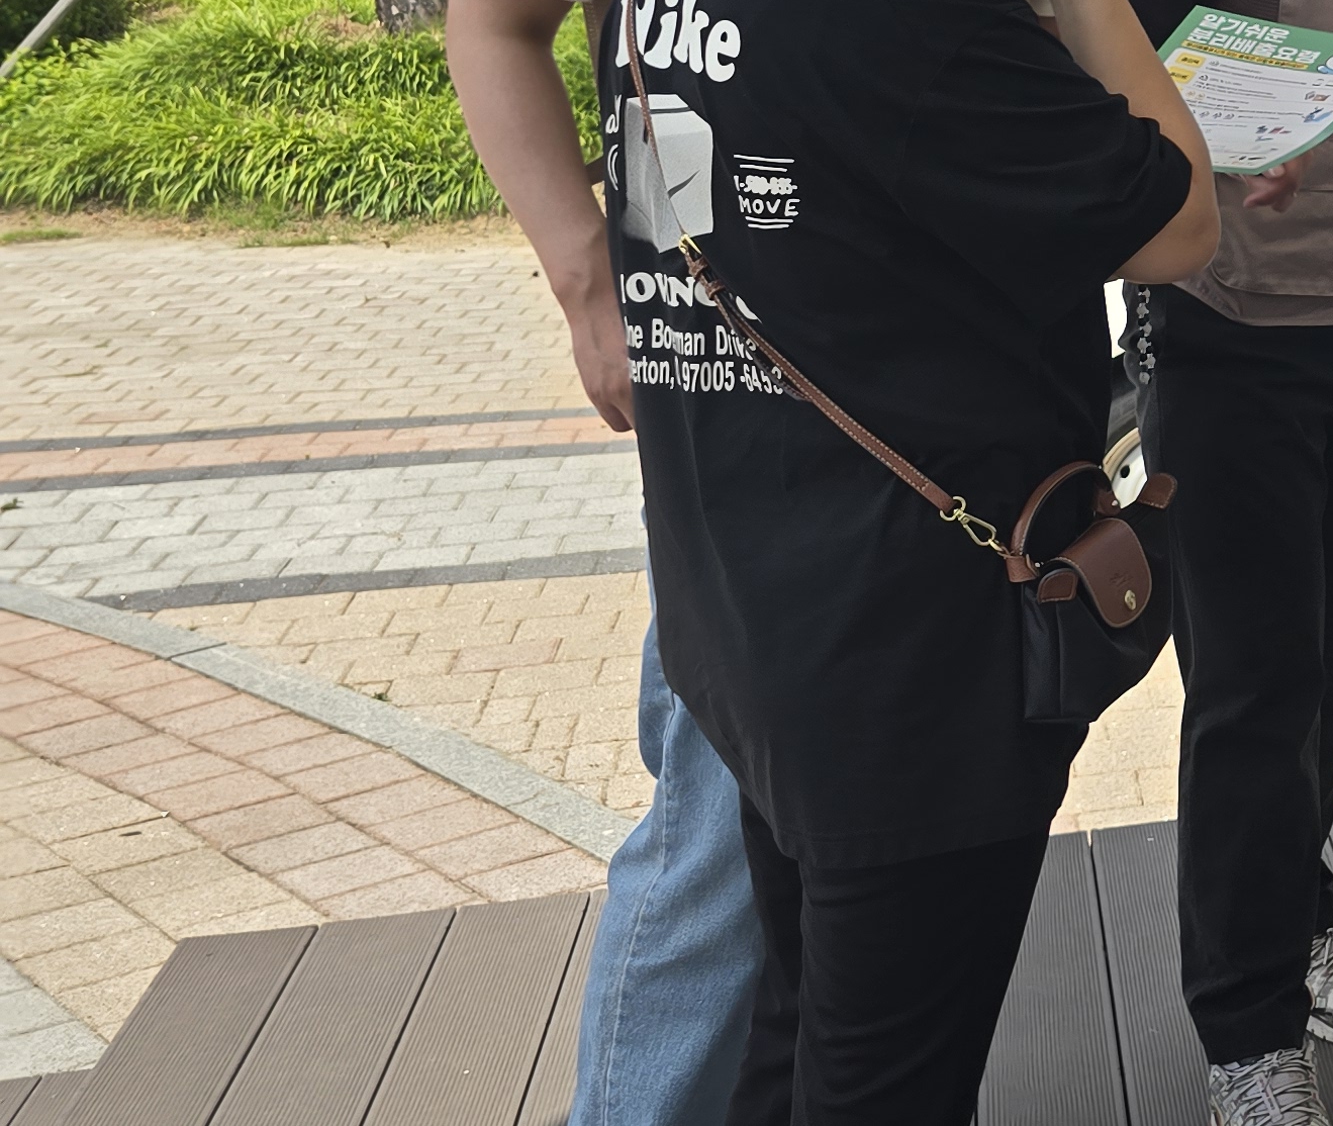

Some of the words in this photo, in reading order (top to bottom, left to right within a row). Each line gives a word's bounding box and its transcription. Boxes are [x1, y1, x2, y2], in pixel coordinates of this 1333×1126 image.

[1198, 13, 1290, 43] 알기쉬운
[1186, 26, 1322, 64] 분리배출요령
[738, 194, 801, 217] MOVE
